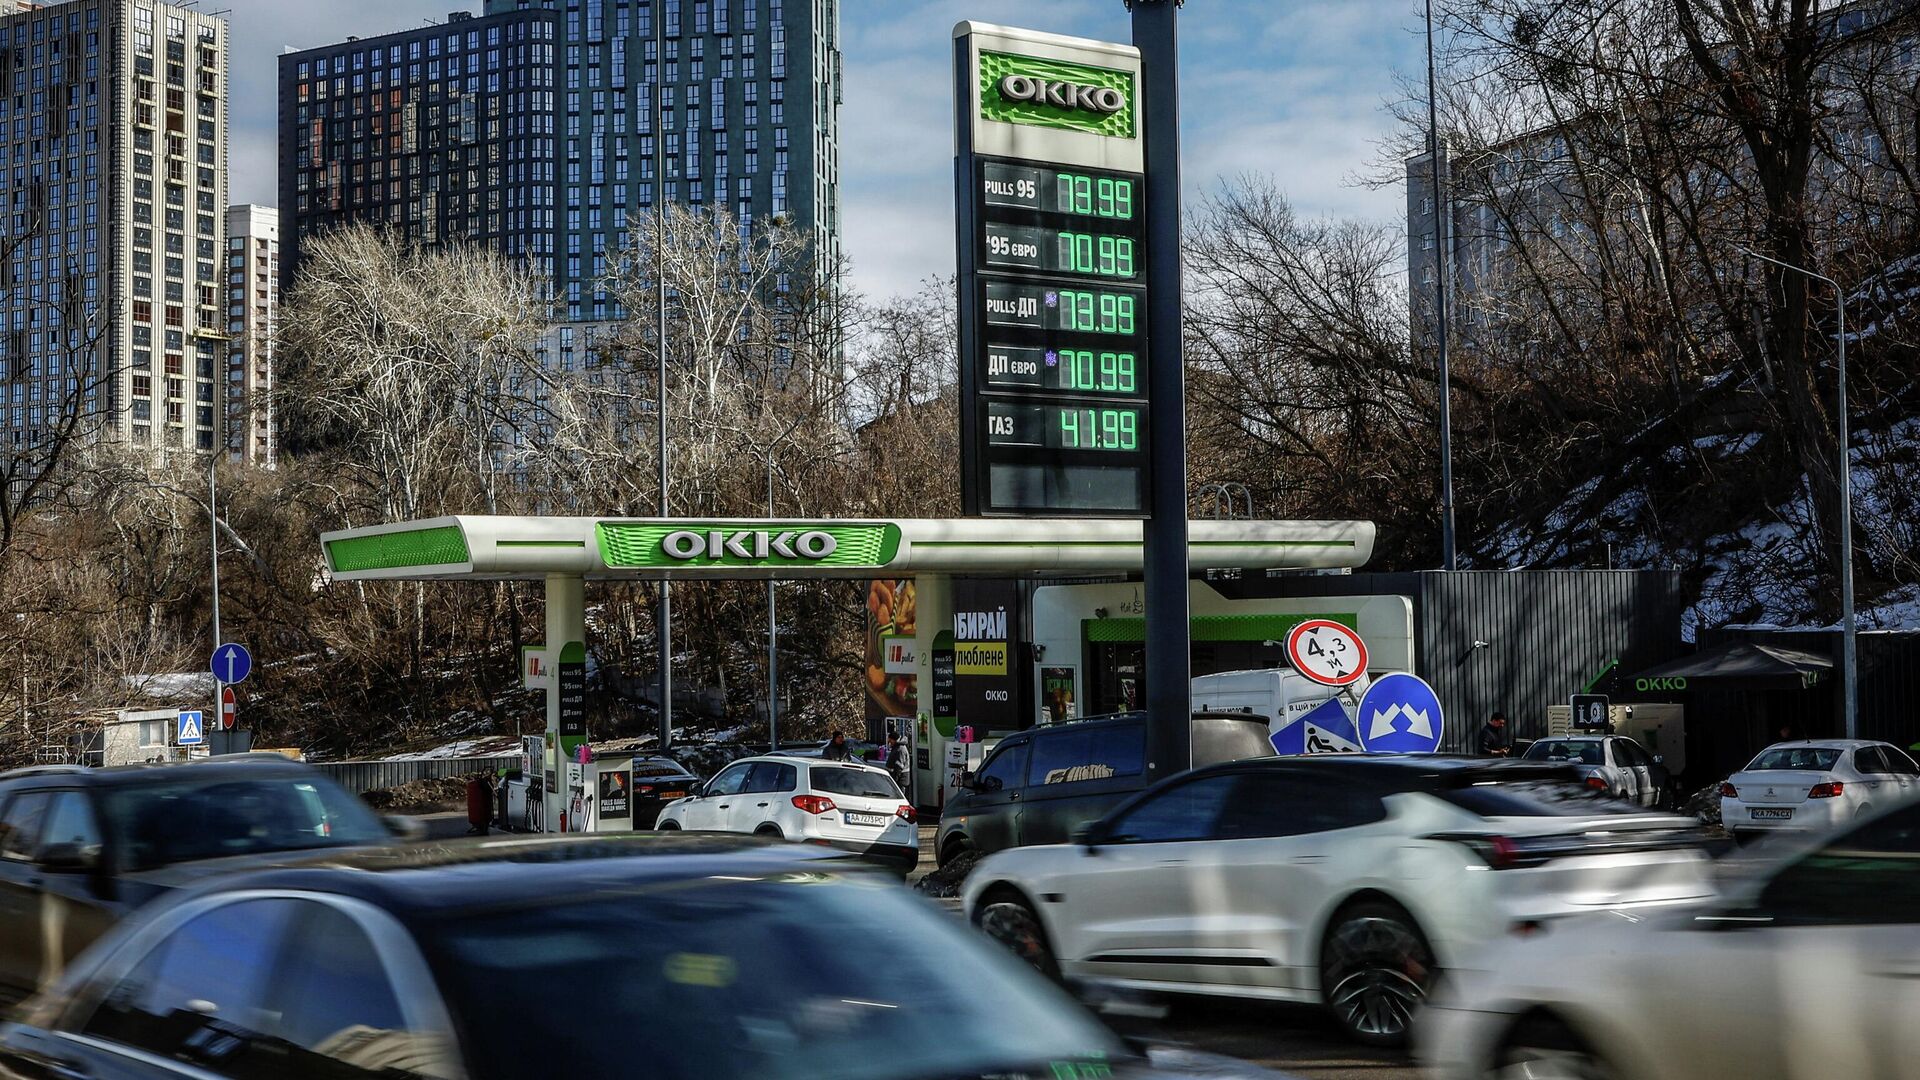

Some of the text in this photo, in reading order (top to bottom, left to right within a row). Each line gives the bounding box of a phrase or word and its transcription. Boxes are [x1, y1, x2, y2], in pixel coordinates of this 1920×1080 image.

[1002, 75, 1126, 112] OKKO
[985, 179, 1036, 199] PULLS 95
[1057, 173, 1133, 219] 73.99
[1011, 243, 1037, 258] ЄВРО
[1058, 232, 1133, 276] 70.99
[987, 297, 1037, 318] PULLS ДП
[1059, 291, 1135, 334] 73.99
[988, 354, 1037, 375] ДП ЄВРО
[1059, 350, 1135, 392] 70.99
[988, 416, 1014, 435] ГАЗ
[1061, 410, 1136, 449] 41.99
[663, 531, 837, 559] OKKO
[954, 606, 1007, 640] БИРАЙ
[955, 645, 1004, 666] люблене
[1308, 638, 1346, 657] 4,3
[1636, 677, 1687, 692] OKKO
